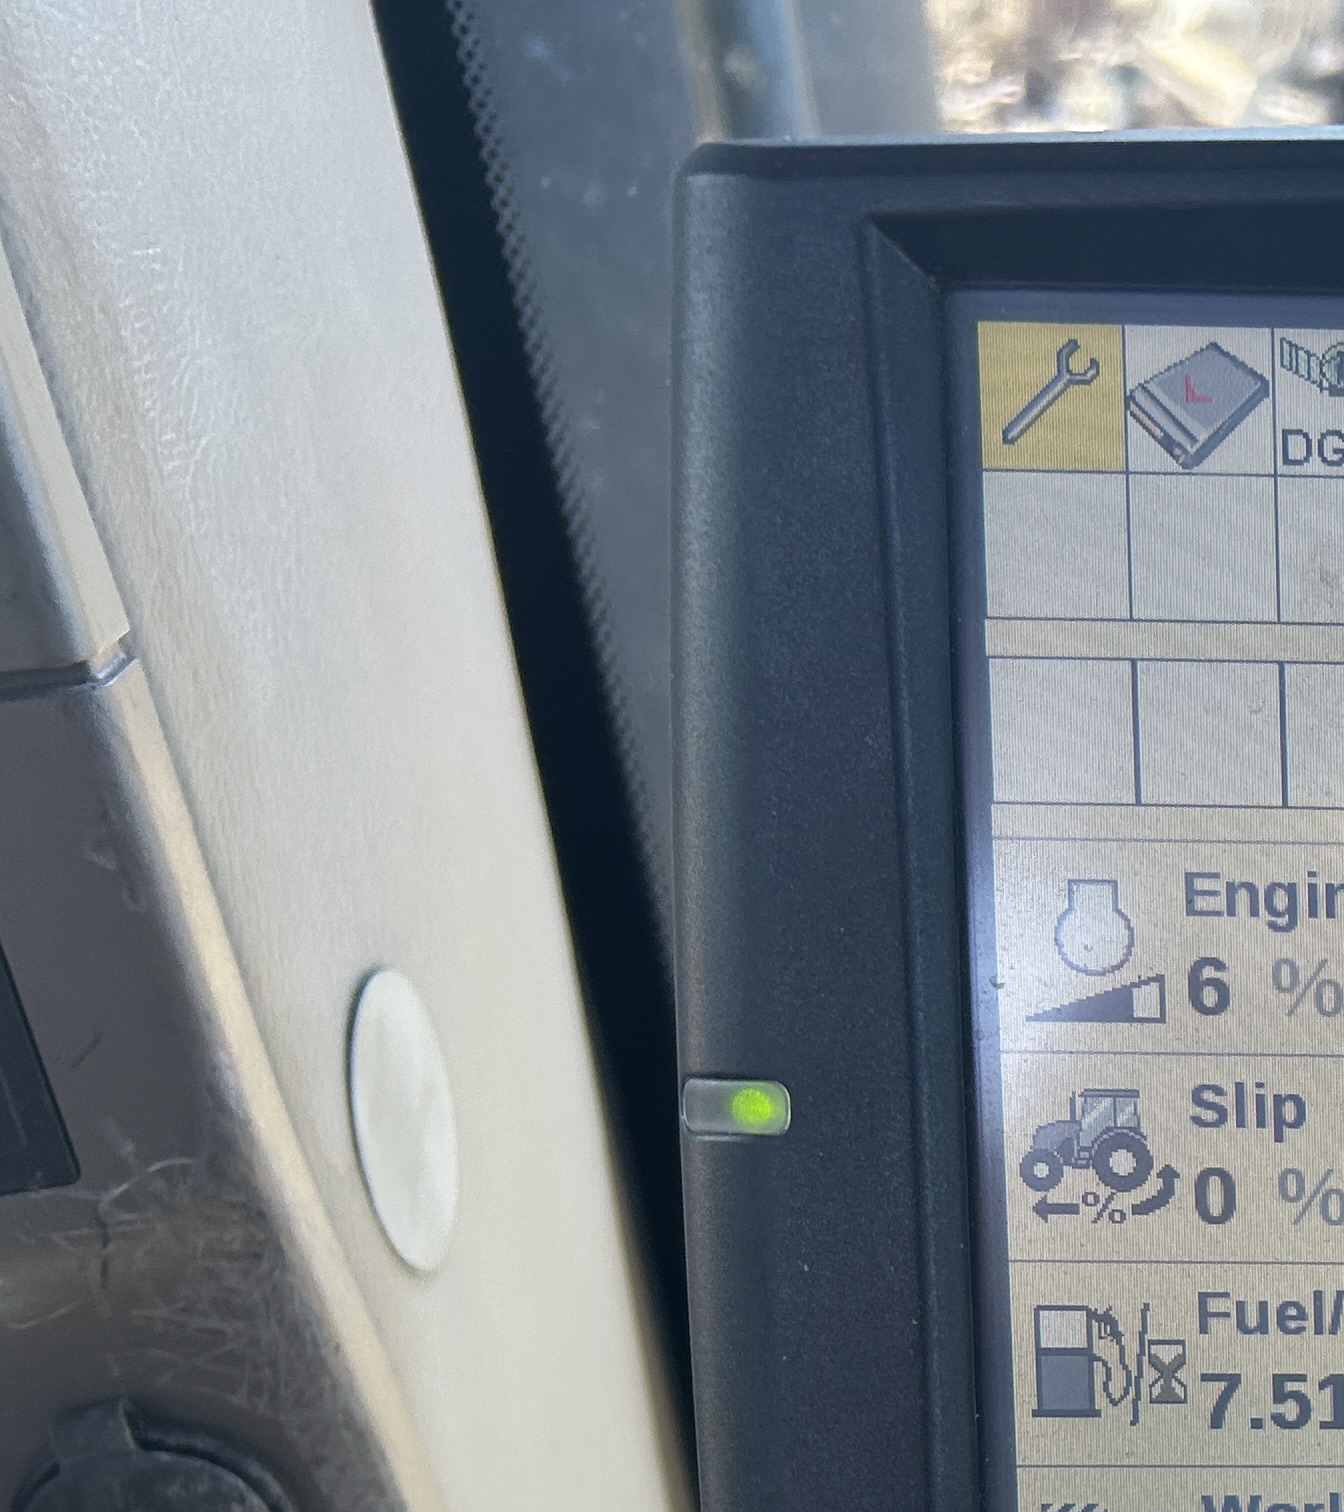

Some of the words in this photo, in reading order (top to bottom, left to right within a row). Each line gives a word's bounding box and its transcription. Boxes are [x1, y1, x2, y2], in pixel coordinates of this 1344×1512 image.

[1187, 956, 1232, 1017] 6
[1271, 957, 1344, 1018] %
[1190, 1081, 1308, 1143] Slip
[1194, 1166, 1237, 1227] 0
